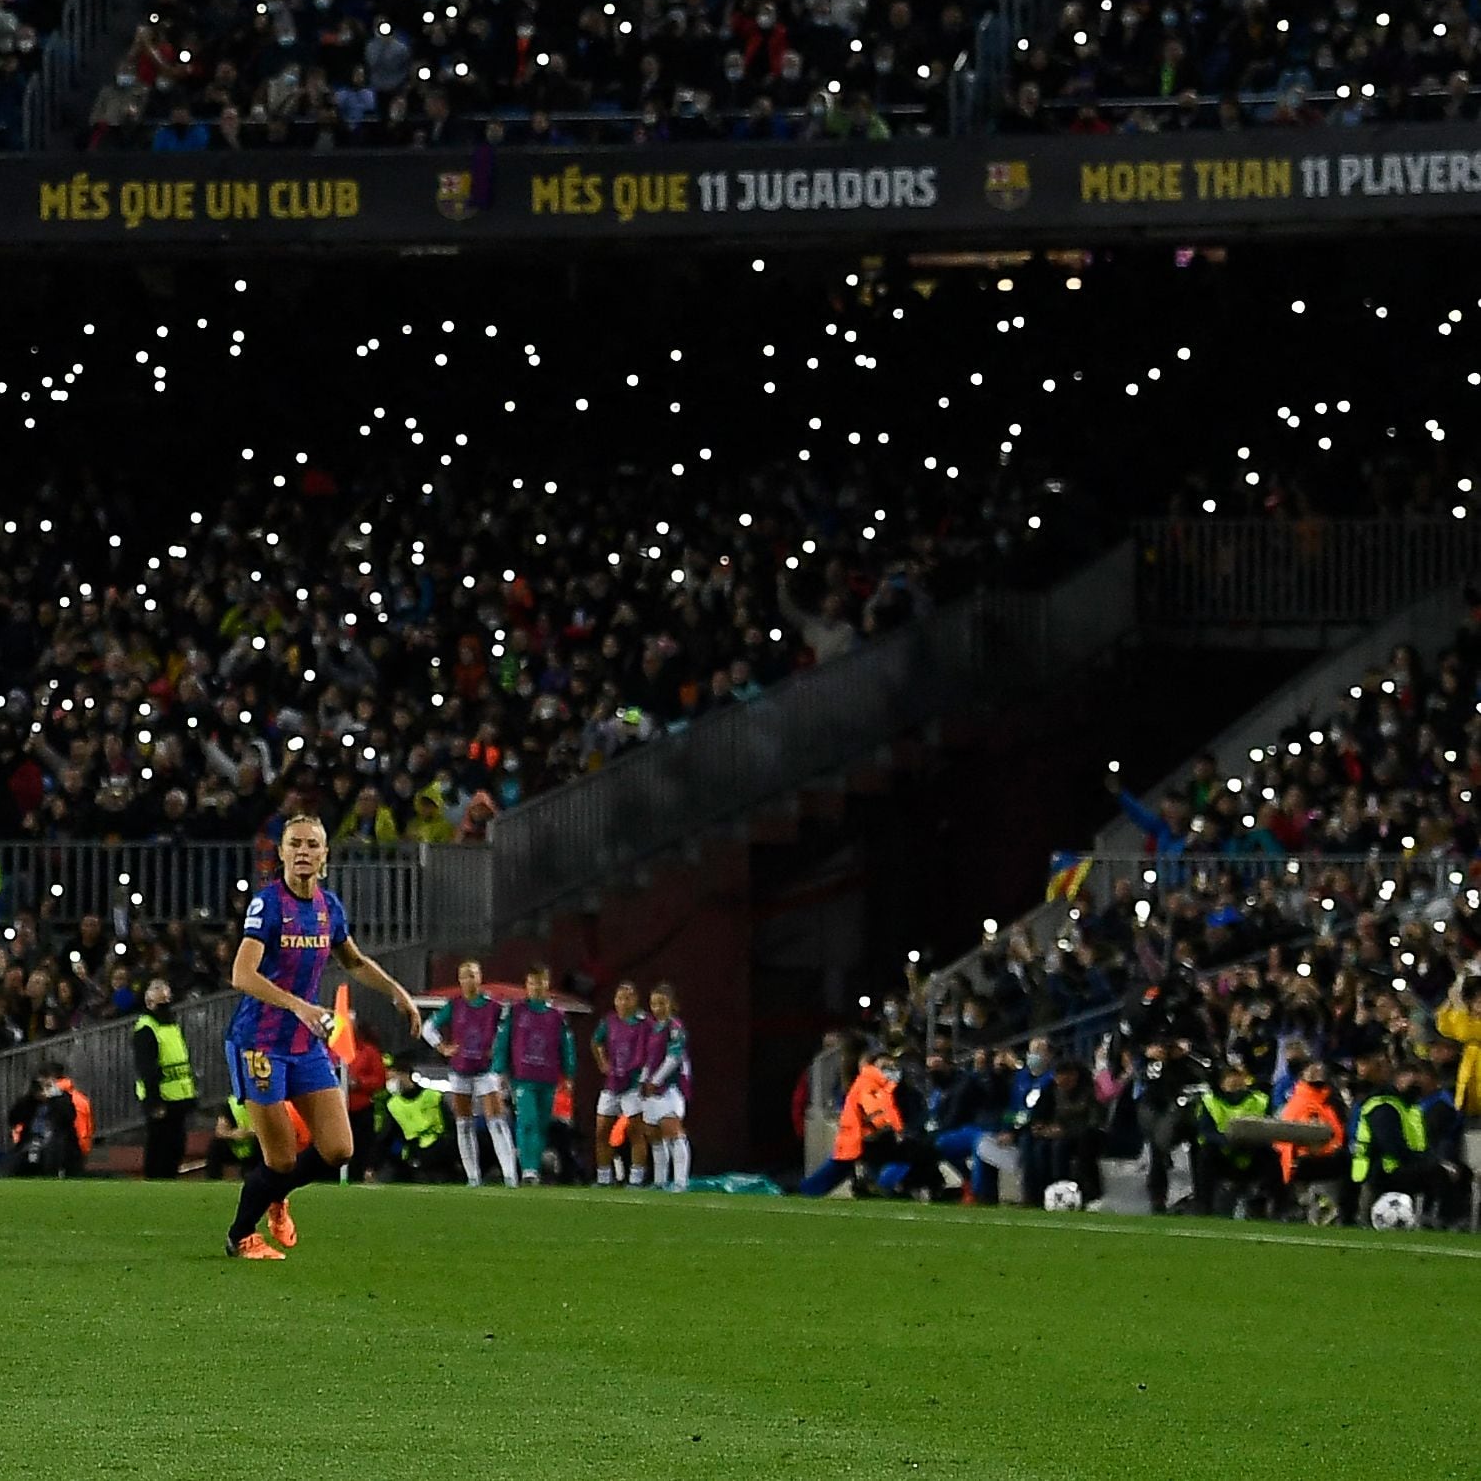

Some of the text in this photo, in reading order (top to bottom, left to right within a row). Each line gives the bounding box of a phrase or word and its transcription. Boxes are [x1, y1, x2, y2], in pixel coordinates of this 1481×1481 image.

[39, 173, 360, 228] MÉS QUE UN CLUB
[530, 166, 938, 221] MÉS QUE 11 JUGADORS
[1080, 163, 1186, 200] MORE
[1193, 161, 1292, 199] THAN
[1301, 159, 1330, 197] 11
